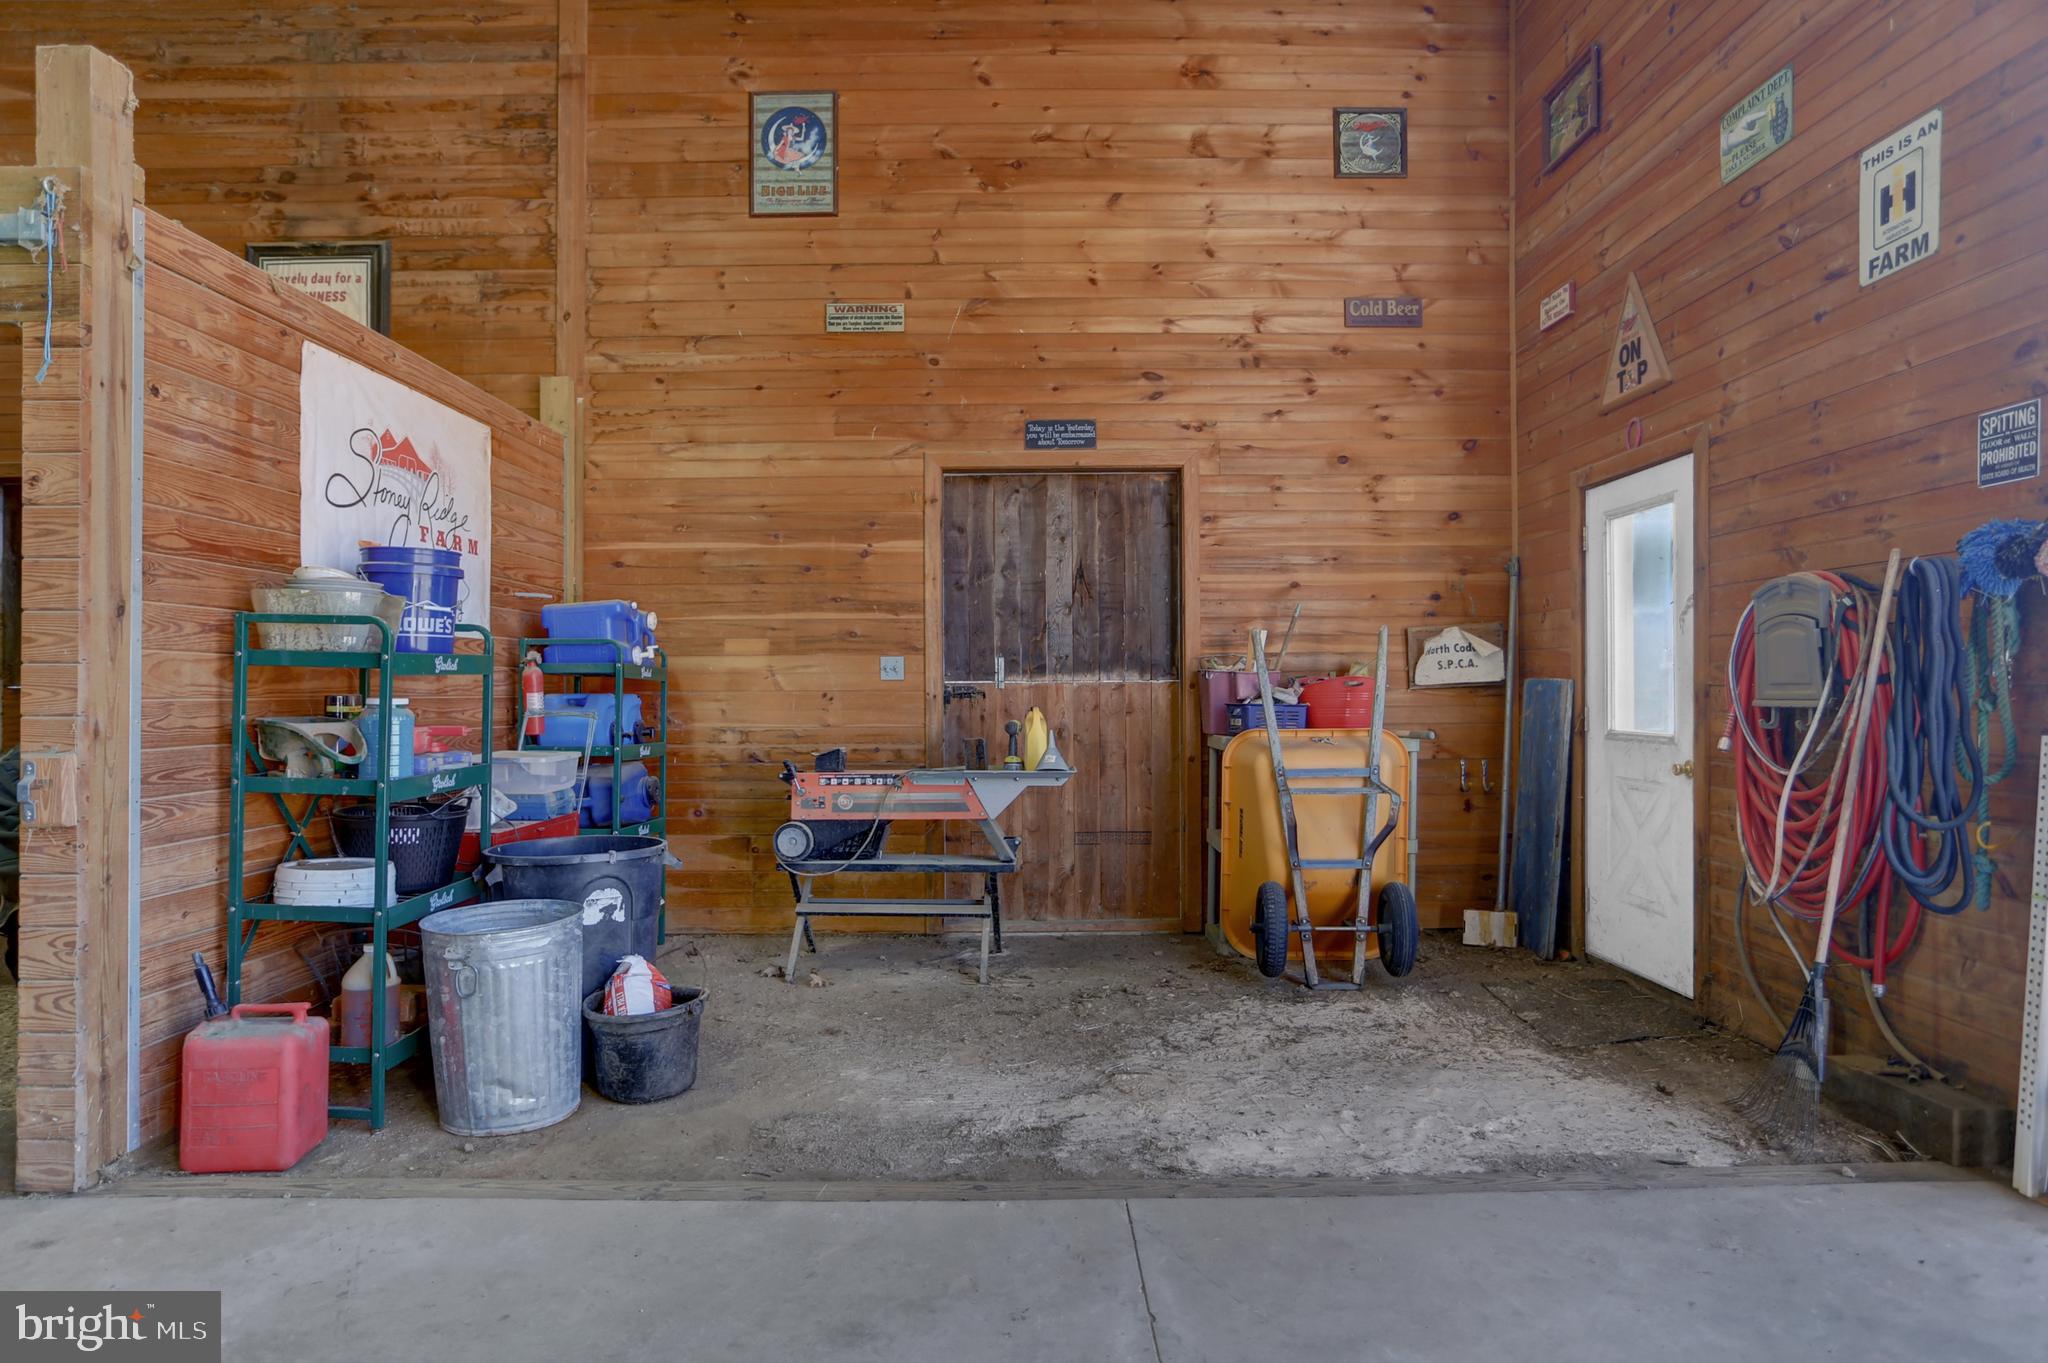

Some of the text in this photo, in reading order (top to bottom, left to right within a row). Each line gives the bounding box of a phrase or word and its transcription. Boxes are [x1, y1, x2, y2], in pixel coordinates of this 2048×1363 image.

[1863, 119, 1939, 171] THIS IS AN
[1868, 232, 1929, 280] FARM
[274, 271, 363, 286] ovely day for a
[833, 305, 898, 313] WARNING
[1349, 300, 1420, 316] Cold Beer
[1619, 336, 1641, 367] ON
[1617, 359, 1648, 393] TP
[1027, 424, 1046, 432] Today
[1982, 406, 2036, 436] SPITTING
[1981, 441, 2037, 467] PROHIBITED
[326, 428, 471, 550] Stoney Ridge
[419, 526, 479, 555] FARM
[400, 616, 453, 633] OWE'S
[1437, 658, 1479, 670] S.P.C.A.
